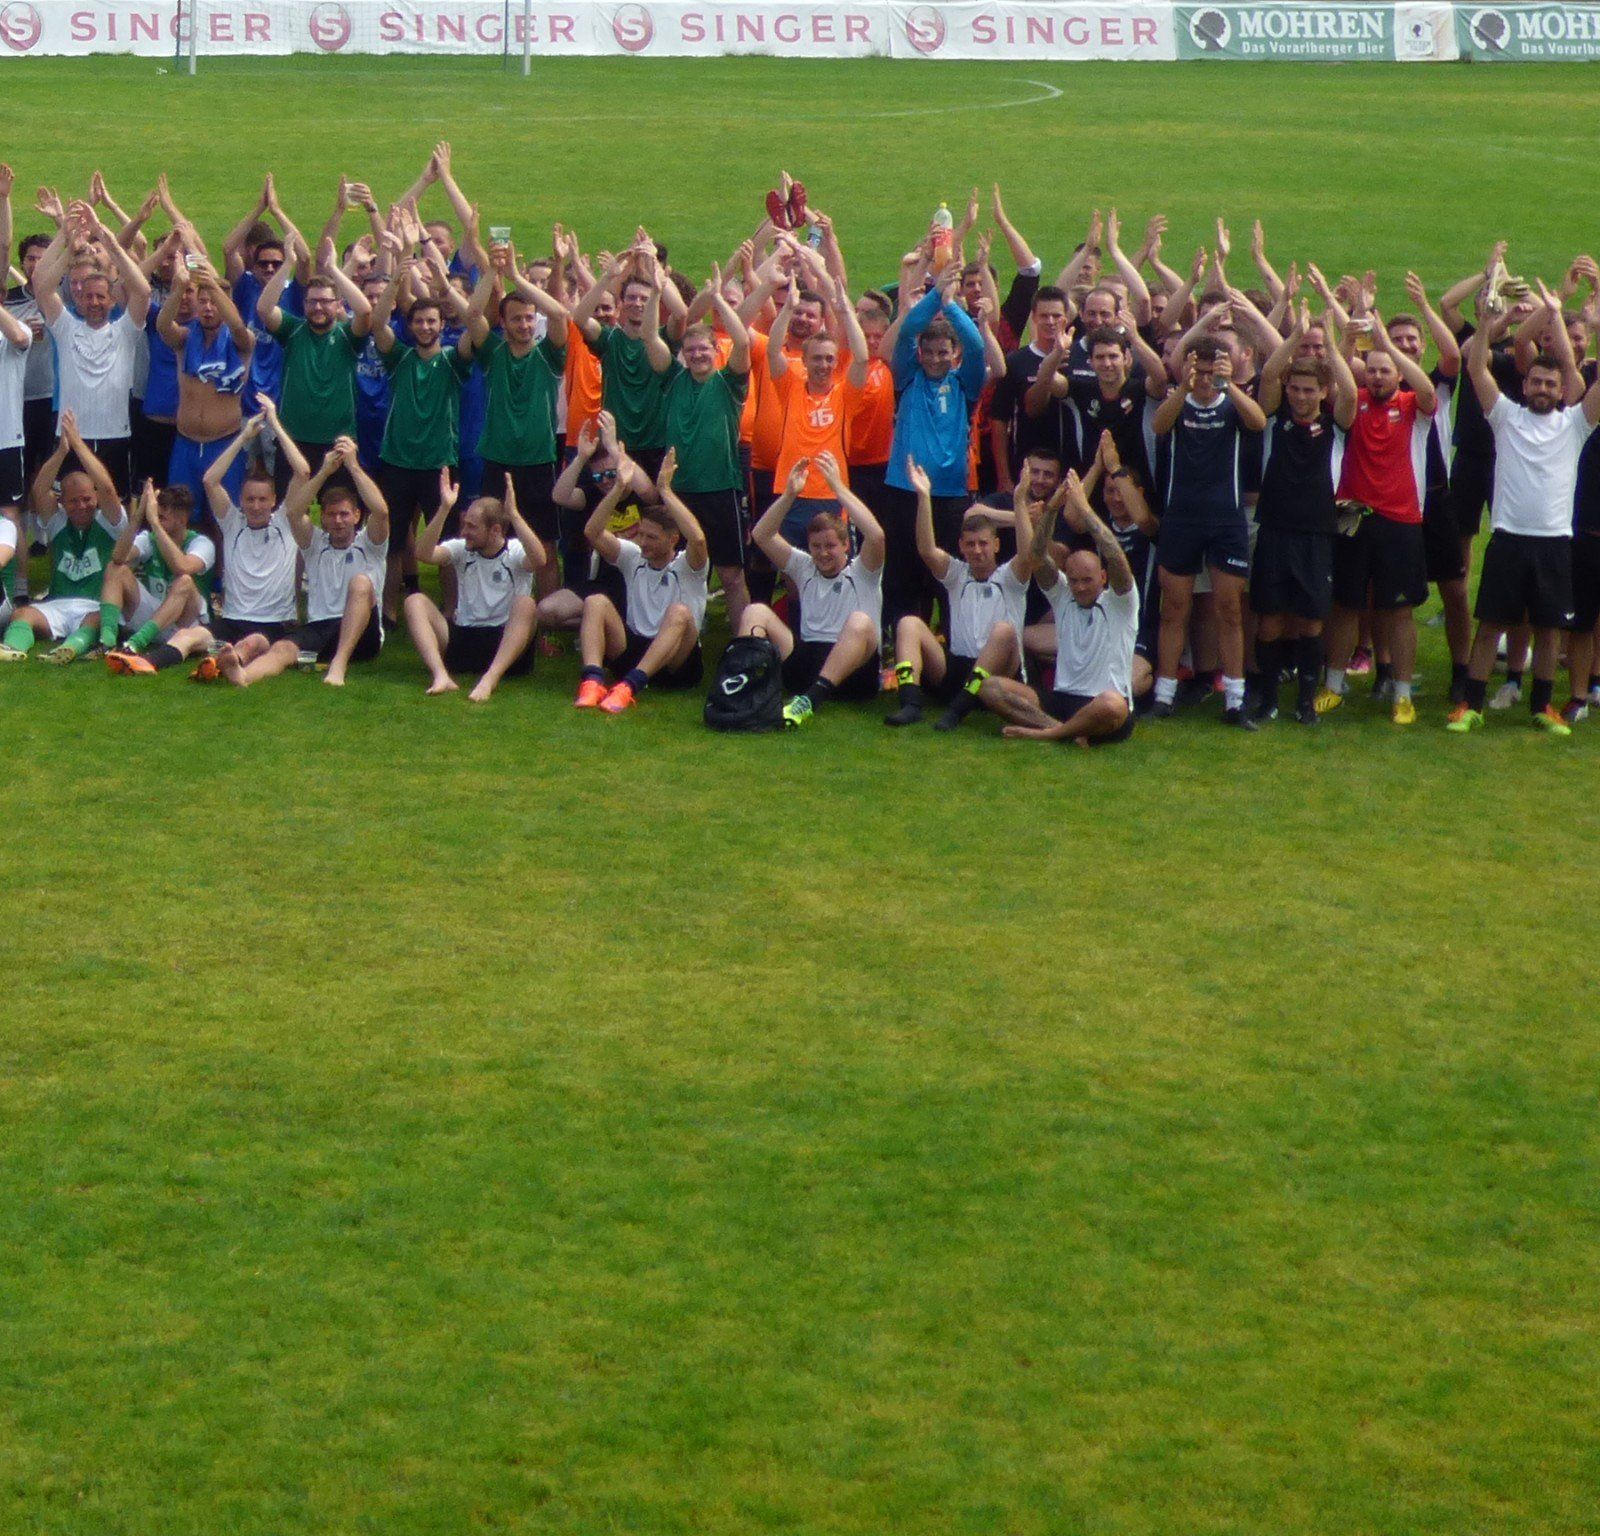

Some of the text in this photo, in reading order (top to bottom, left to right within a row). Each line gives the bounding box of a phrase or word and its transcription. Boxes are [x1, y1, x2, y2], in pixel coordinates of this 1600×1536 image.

[70, 10, 272, 43] SINGER
[379, 11, 577, 44] SINGER
[680, 12, 873, 44] SINGER
[971, 13, 1159, 45] SINGER
[1237, 10, 1385, 39] MOHREN
[1242, 41, 1385, 57] Das Vorarlberger Bier
[1521, 42, 1545, 55] Das
[807, 408, 834, 428] 16
[938, 396, 947, 413] 1
